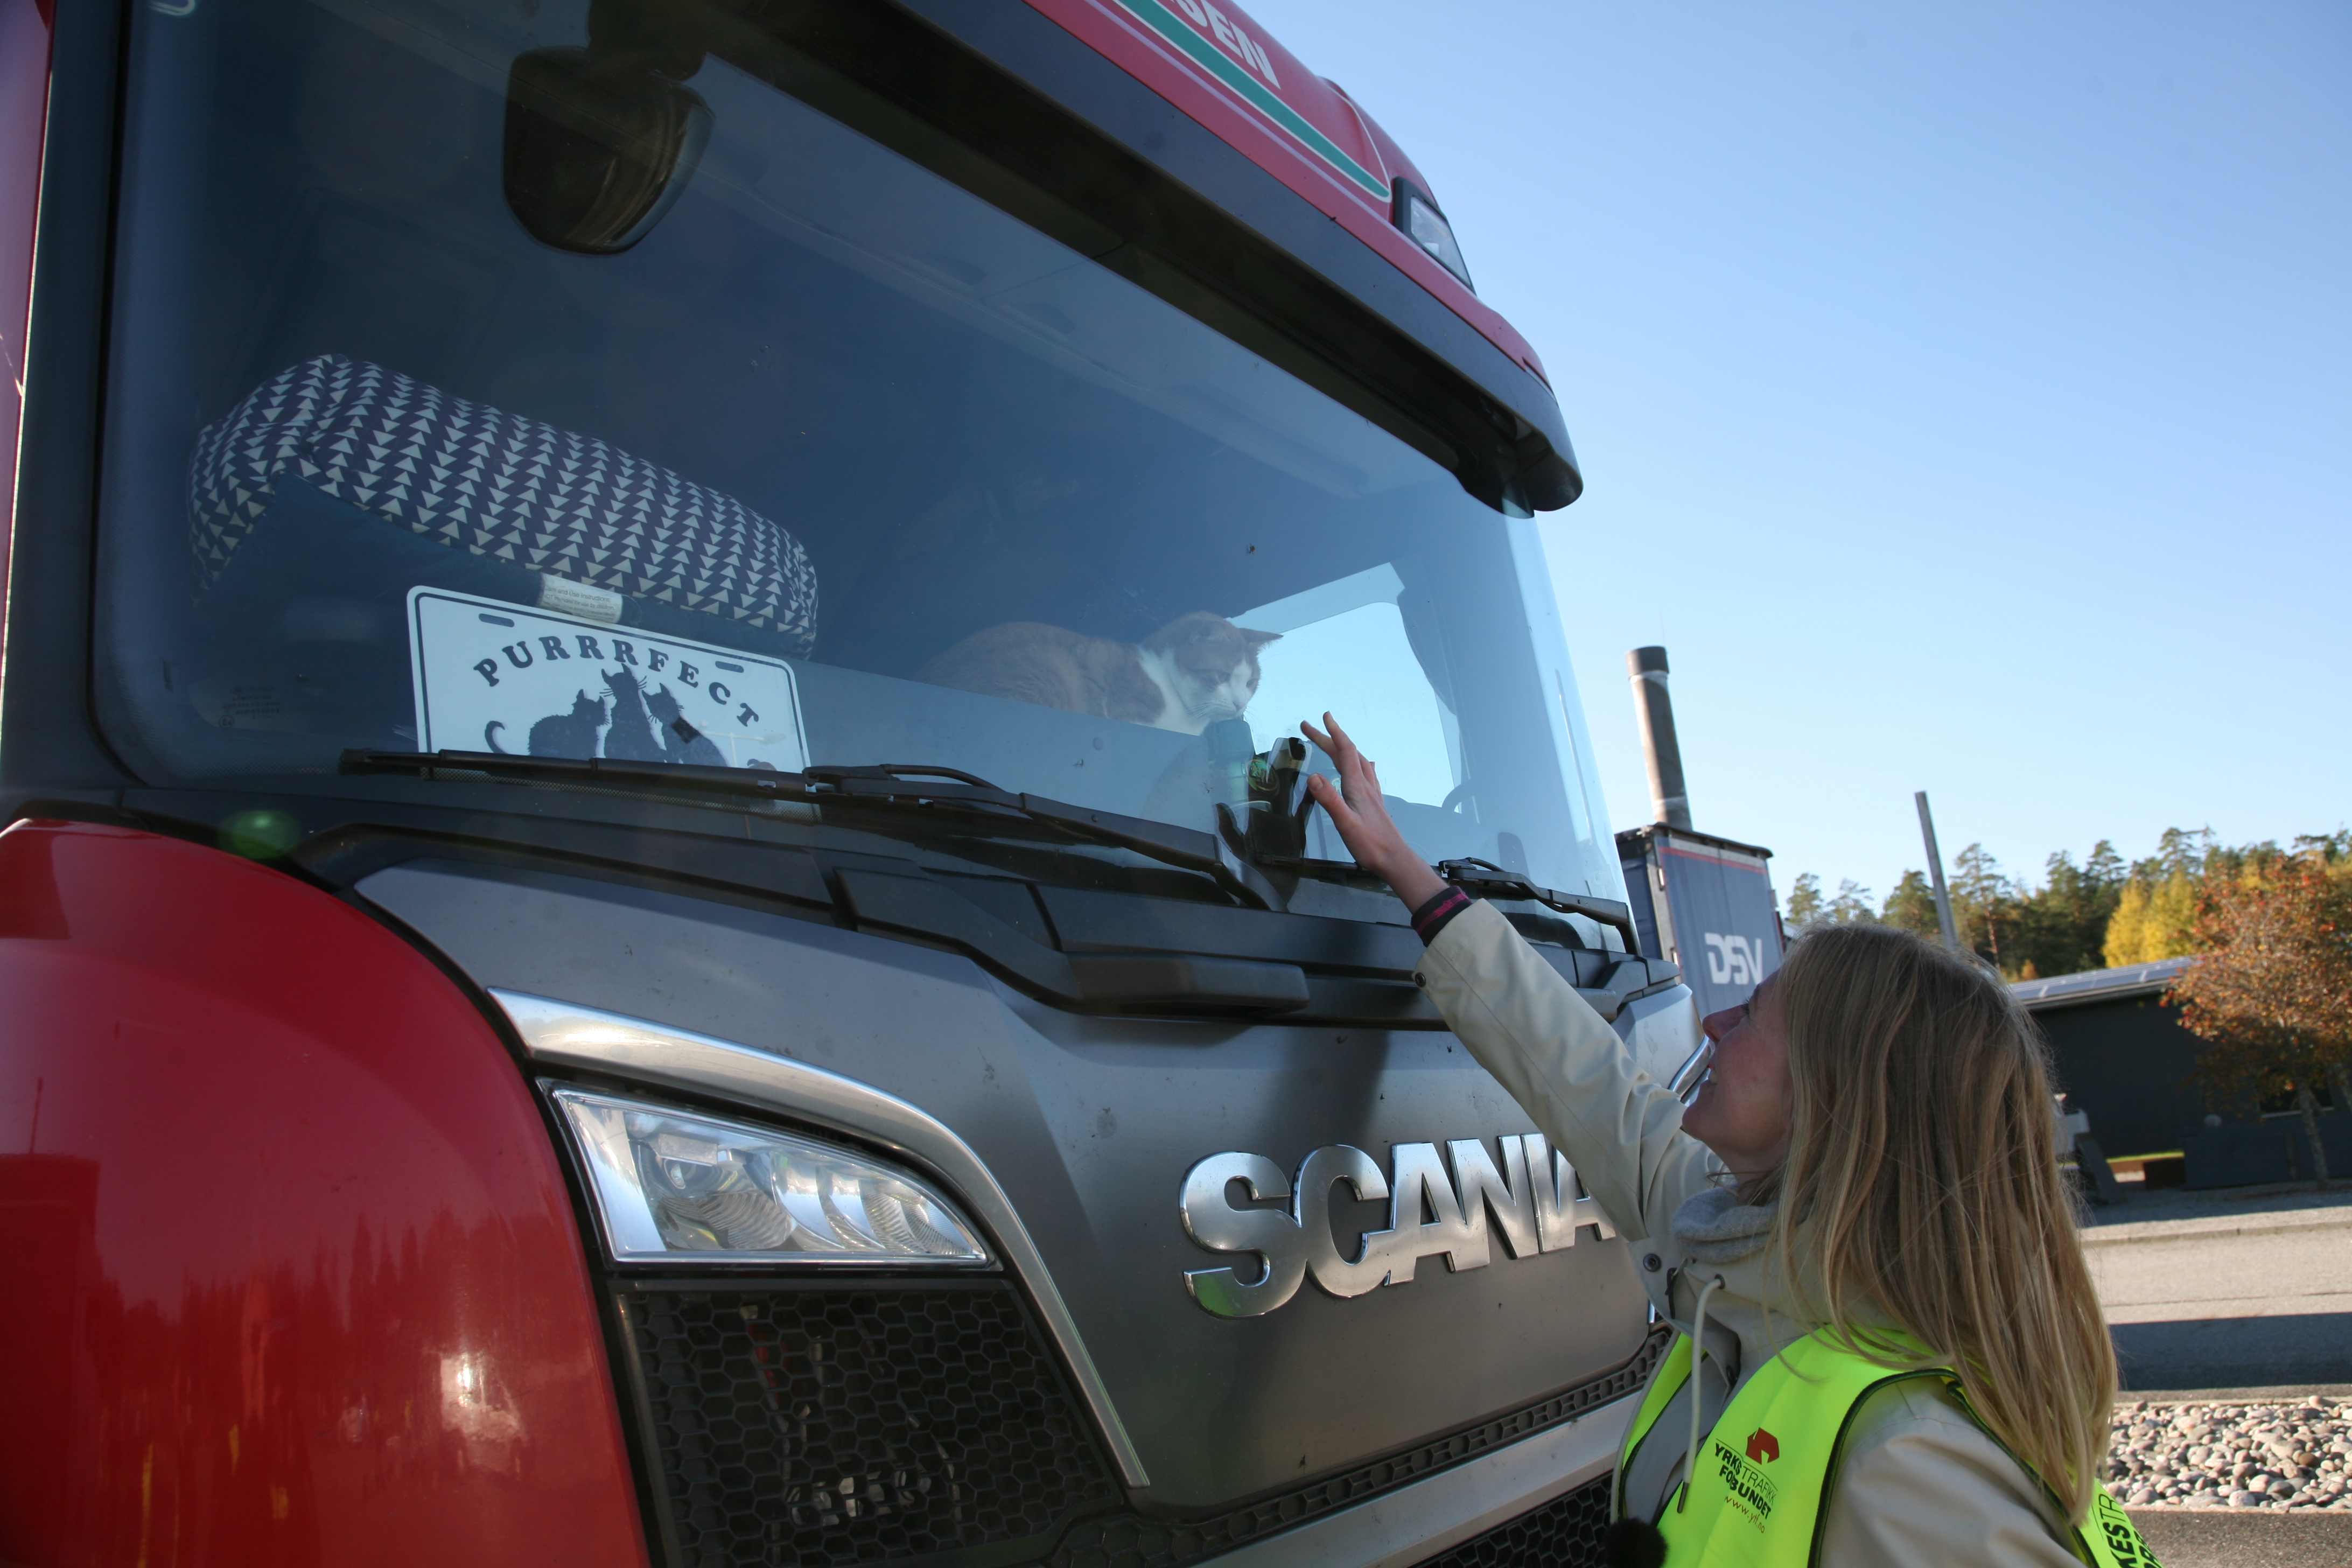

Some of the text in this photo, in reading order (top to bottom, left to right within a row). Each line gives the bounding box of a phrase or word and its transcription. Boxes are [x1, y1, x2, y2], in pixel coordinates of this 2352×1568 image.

[1171, 0, 1282, 90] SEN
[473, 634, 760, 727] PURRRFECT
[1704, 932, 1763, 985] DSV
[1179, 1132, 1616, 1320] SCANIA
